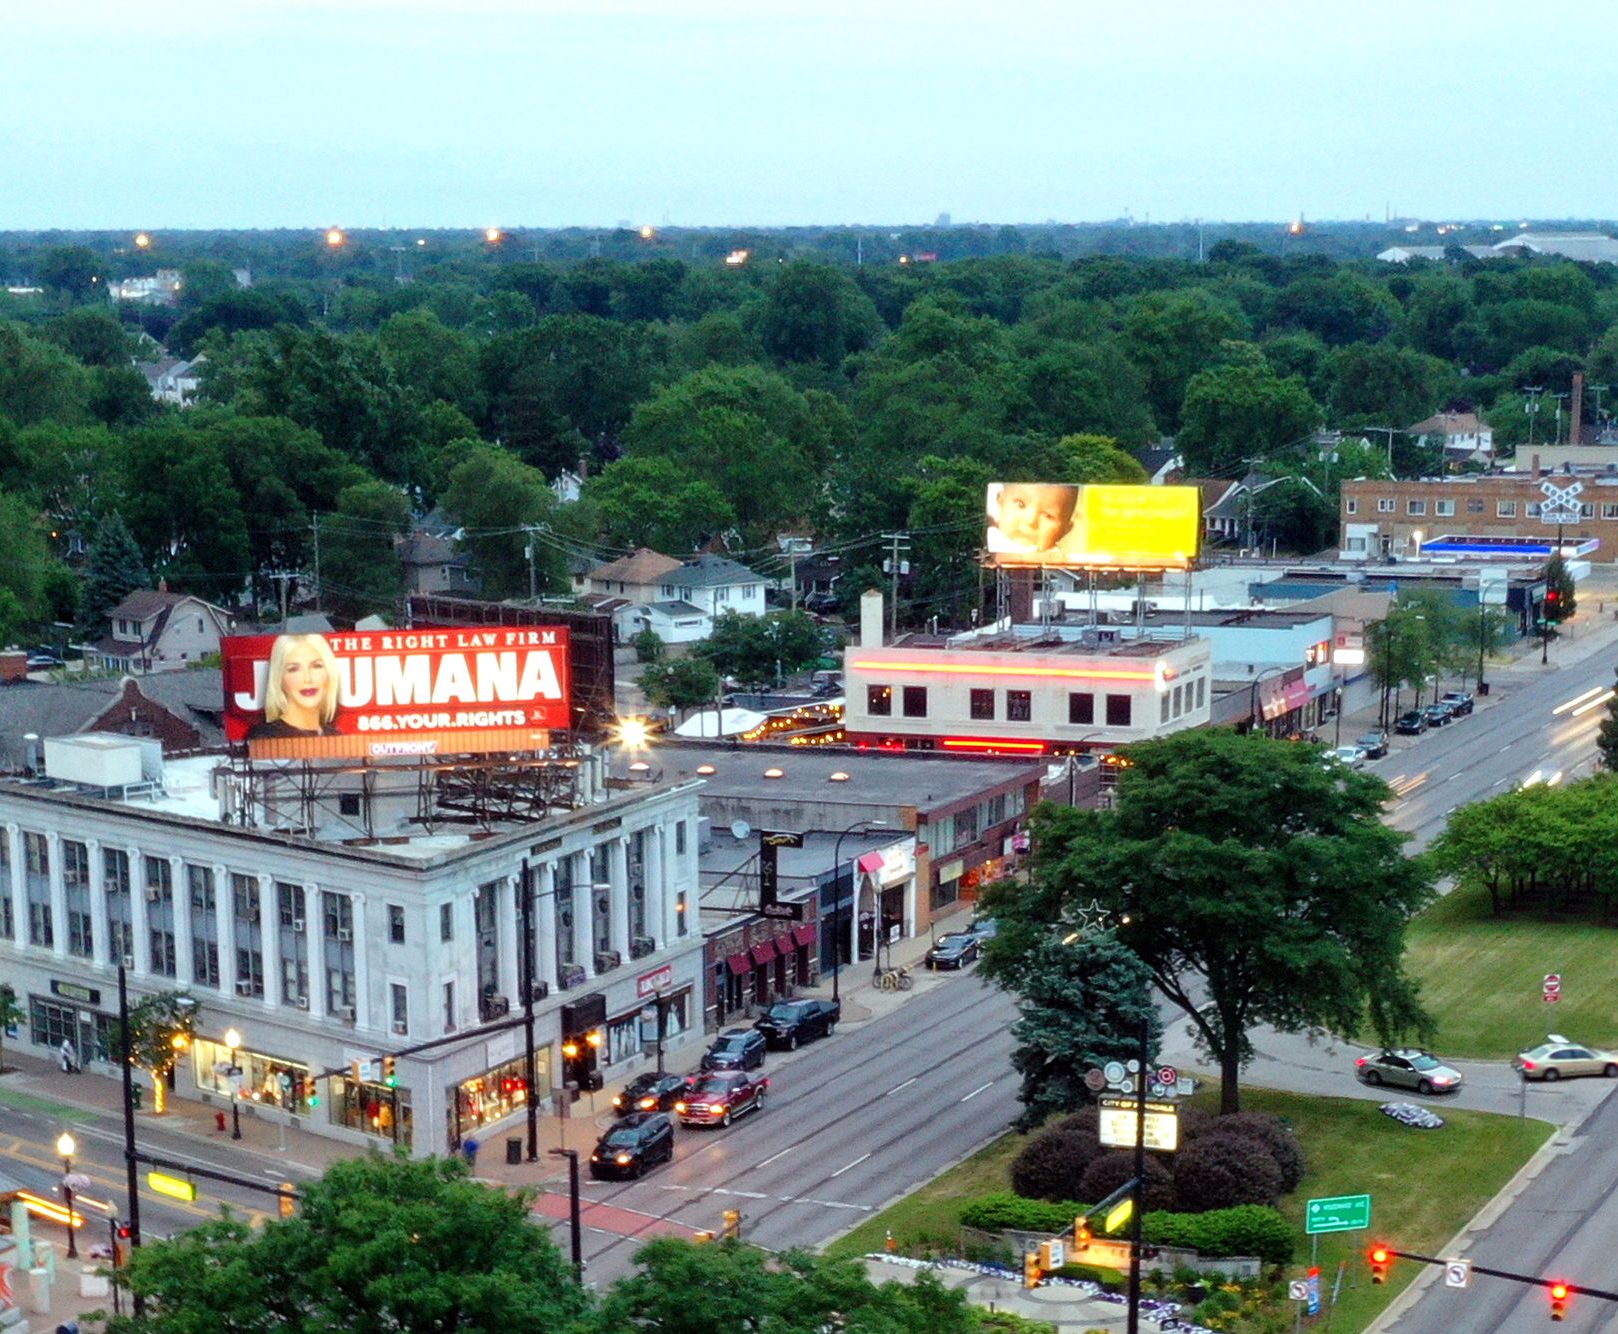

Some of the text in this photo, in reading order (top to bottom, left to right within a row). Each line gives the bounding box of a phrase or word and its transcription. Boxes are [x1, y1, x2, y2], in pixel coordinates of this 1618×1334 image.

[331, 631, 556, 651] THE RIGHT LAW FIRM
[234, 650, 562, 711] JUMANA
[357, 710, 525, 731] 866.YOUR.RIGHTS
